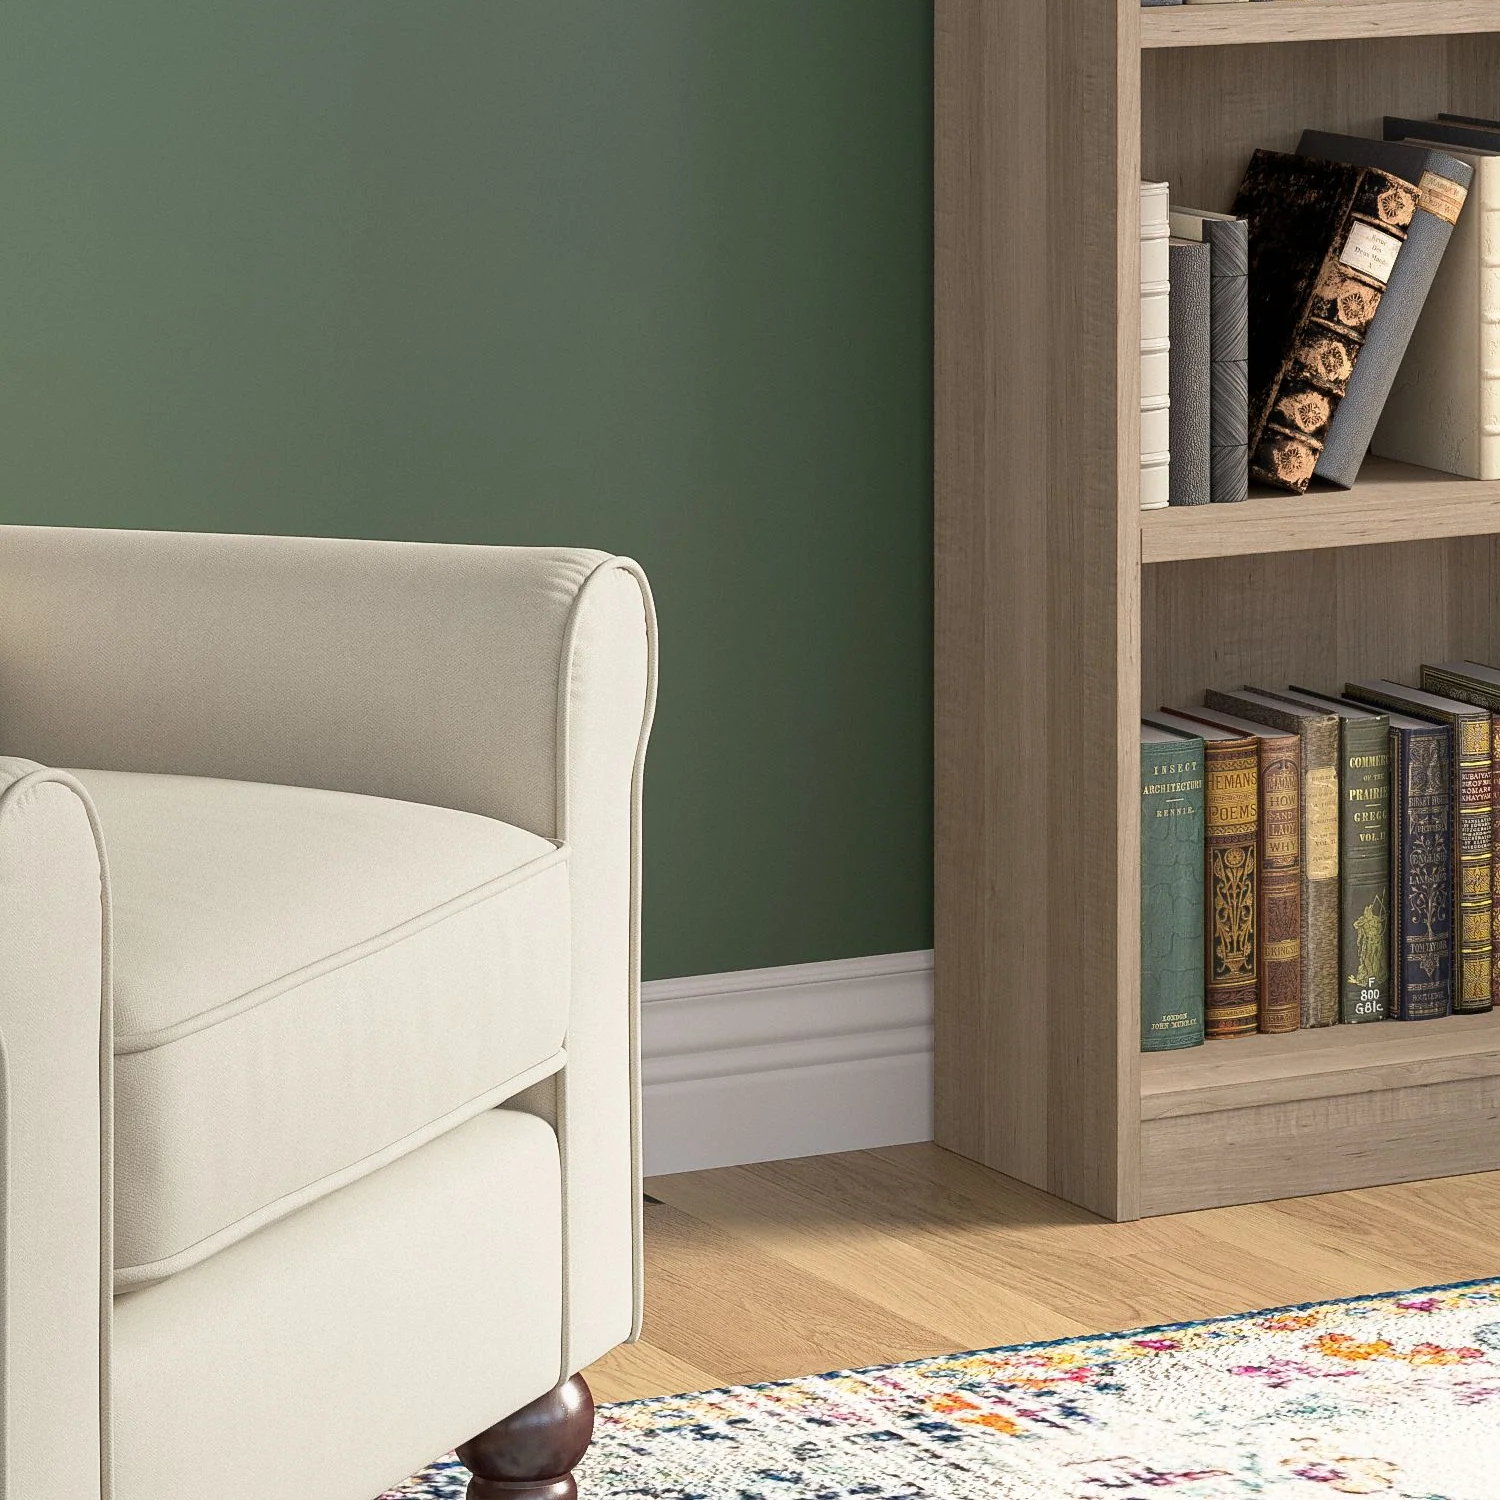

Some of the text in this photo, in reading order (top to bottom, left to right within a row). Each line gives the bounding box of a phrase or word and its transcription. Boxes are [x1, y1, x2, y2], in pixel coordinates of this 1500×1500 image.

[1153, 761, 1197, 776] INSECT
[1206, 771, 1257, 791] HEMANS
[1269, 794, 1296, 807] HOW
[1208, 803, 1257, 824] POEMS
[1271, 823, 1296, 836] LADY
[1359, 832, 1379, 842] VOL.
[1269, 840, 1296, 853] WHY
[1368, 976, 1376, 988] F
[1360, 988, 1380, 1001] 800
[1161, 1012, 1188, 1022] LONDON
[1151, 1022, 1170, 1030] JOHN
